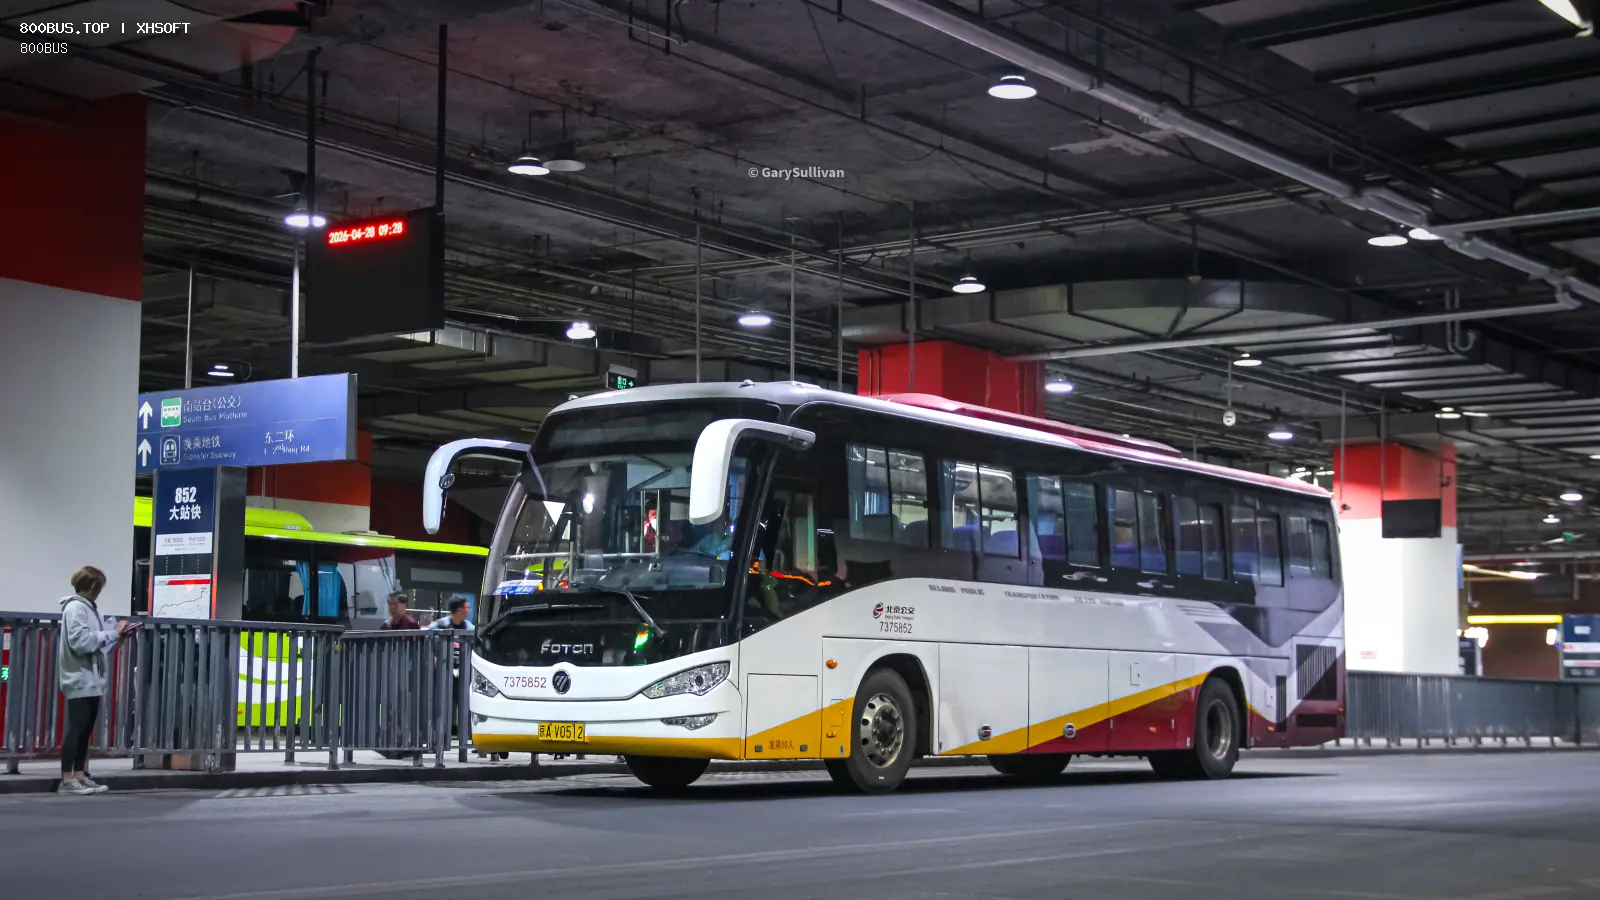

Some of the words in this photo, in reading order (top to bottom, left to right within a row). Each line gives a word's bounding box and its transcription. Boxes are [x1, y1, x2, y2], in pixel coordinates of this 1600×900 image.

[328, 226, 375, 244] 2026-04-28
[378, 221, 403, 236] 09:28
[183, 415, 203, 423] South
[204, 413, 217, 422] Bus
[219, 411, 248, 421] Platform
[183, 434, 221, 451] 换乘地铁
[264, 429, 295, 444] 东二环
[300, 444, 310, 453] Rd
[183, 452, 209, 461] Transfer
[210, 451, 237, 460] Subway
[174, 486, 197, 504] 852
[168, 504, 202, 521] 大站快
[885, 605, 915, 615] 北京公交
[879, 621, 913, 634] 7375852
[540, 643, 594, 654] FOTON
[503, 676, 547, 689] 7375852
